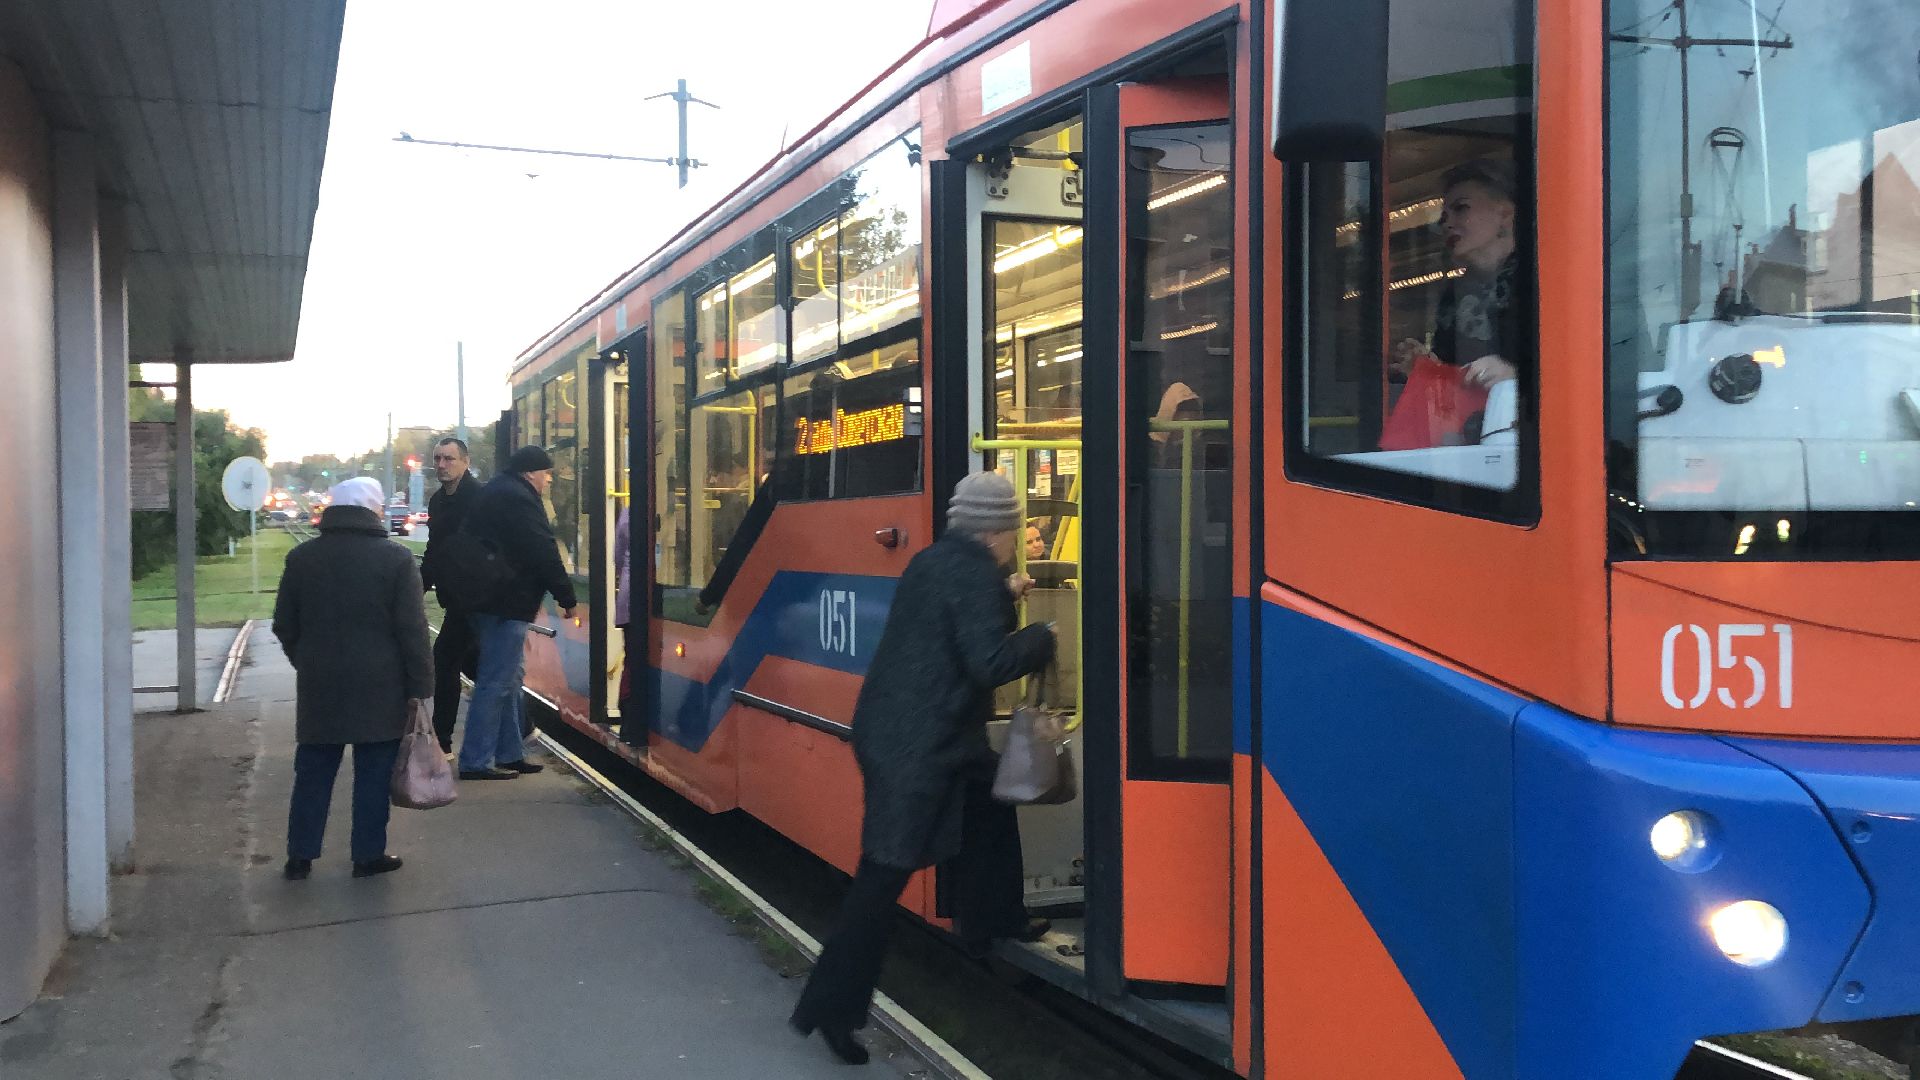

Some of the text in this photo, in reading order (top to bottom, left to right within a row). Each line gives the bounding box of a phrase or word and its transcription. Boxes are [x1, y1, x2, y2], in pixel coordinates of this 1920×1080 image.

[795, 416, 808, 455] 2
[820, 589, 855, 656] 051
[1661, 623, 1793, 709] 051
